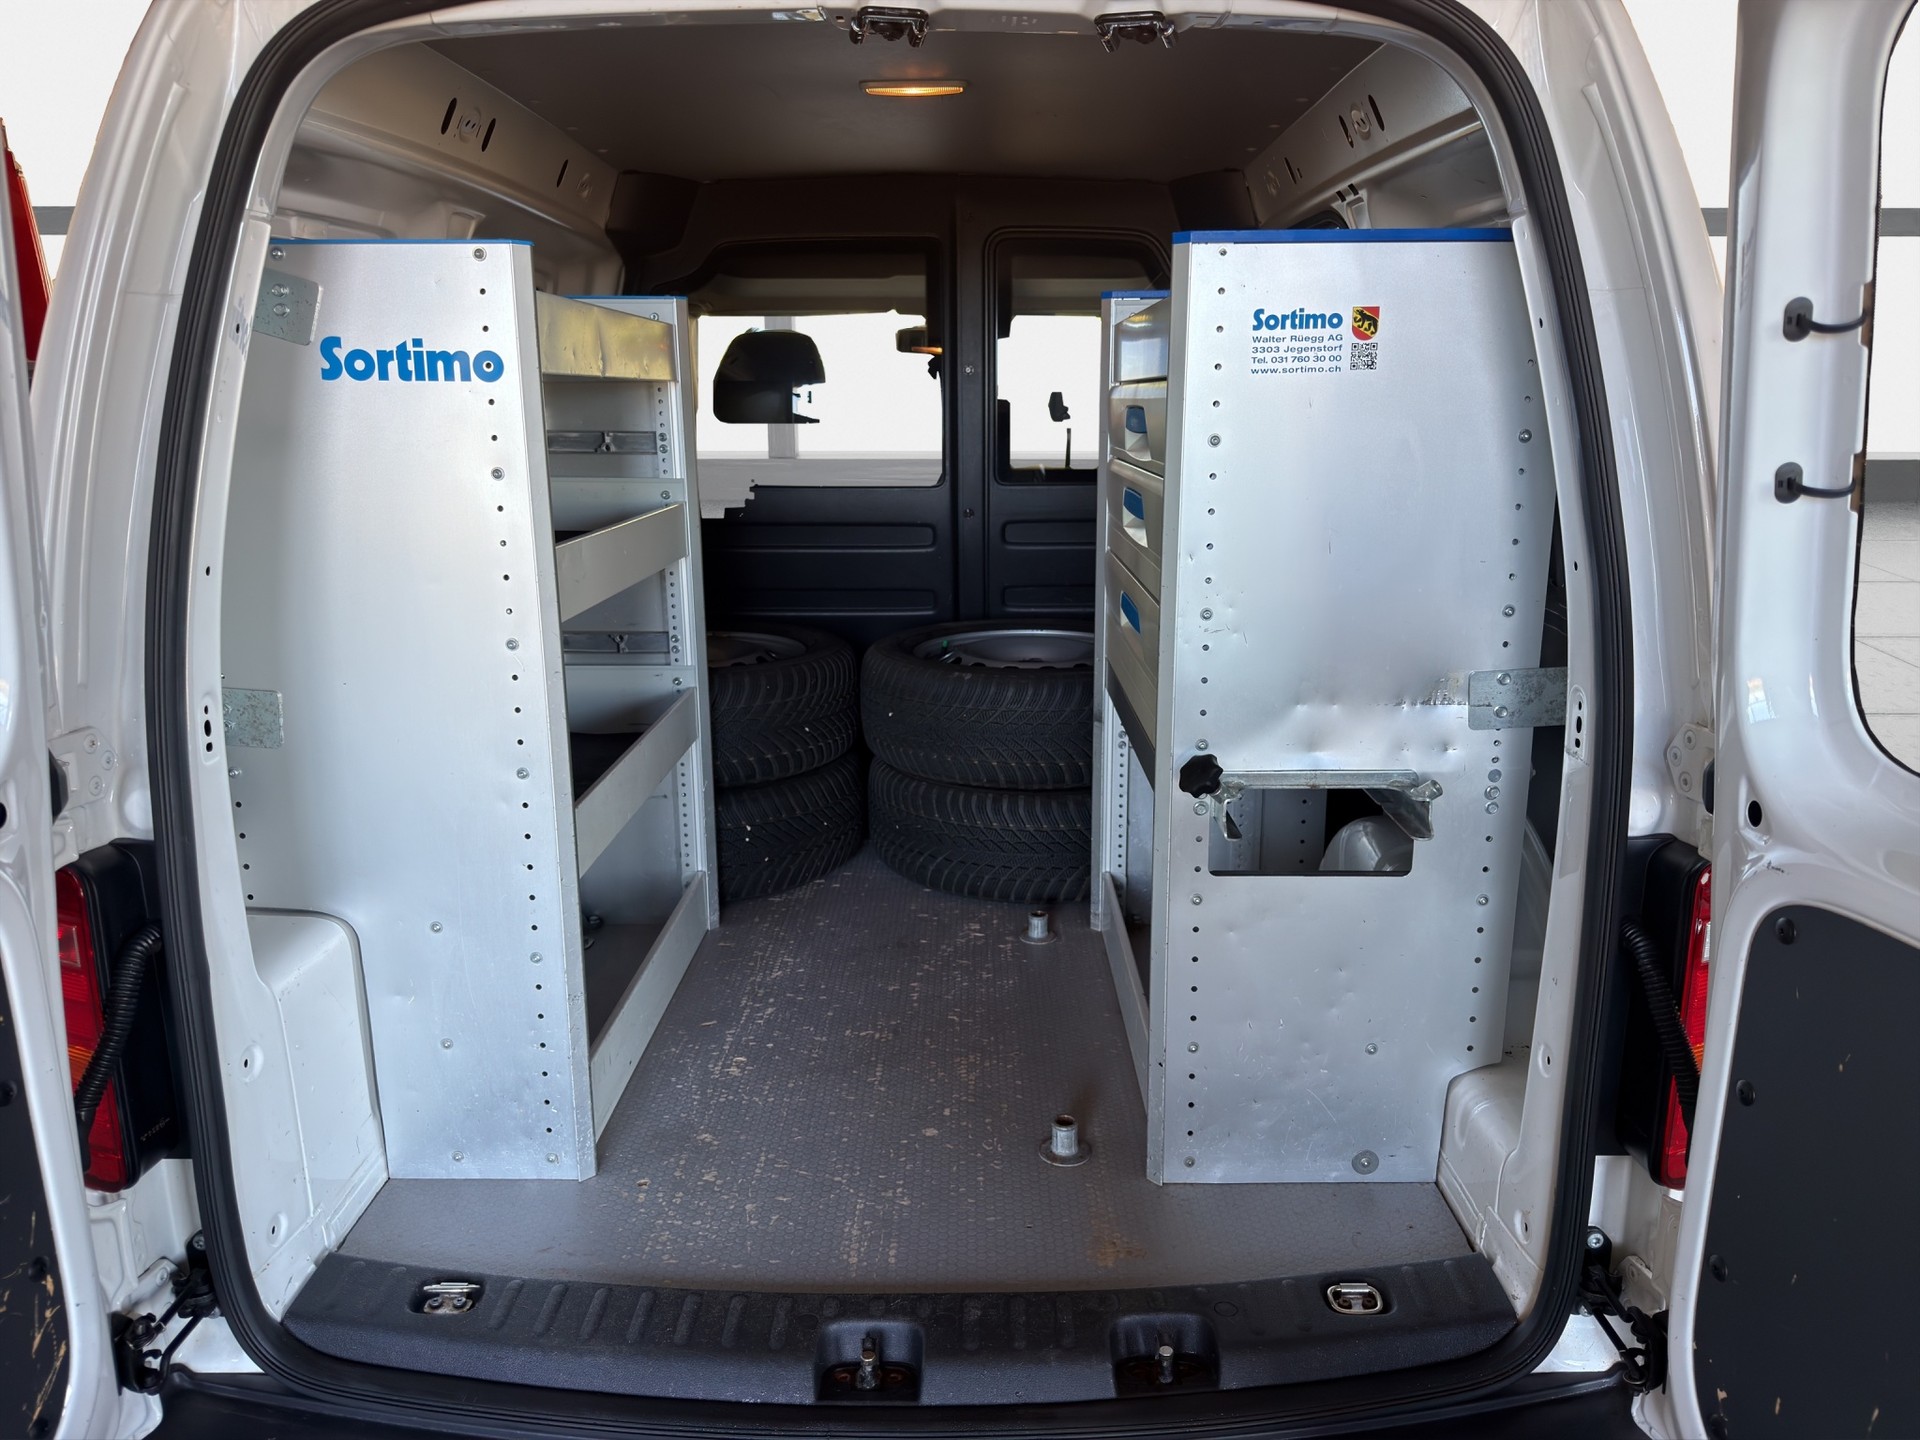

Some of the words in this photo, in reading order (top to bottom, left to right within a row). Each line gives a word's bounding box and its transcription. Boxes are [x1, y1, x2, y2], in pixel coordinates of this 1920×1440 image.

[1252, 308, 1343, 331] Sortimo
[1290, 335, 1324, 343] Rüegg
[1284, 345, 1343, 354] Jegenstorf
[320, 336, 504, 382] Sortimo
[1251, 366, 1341, 374] www.sortimo.ch
